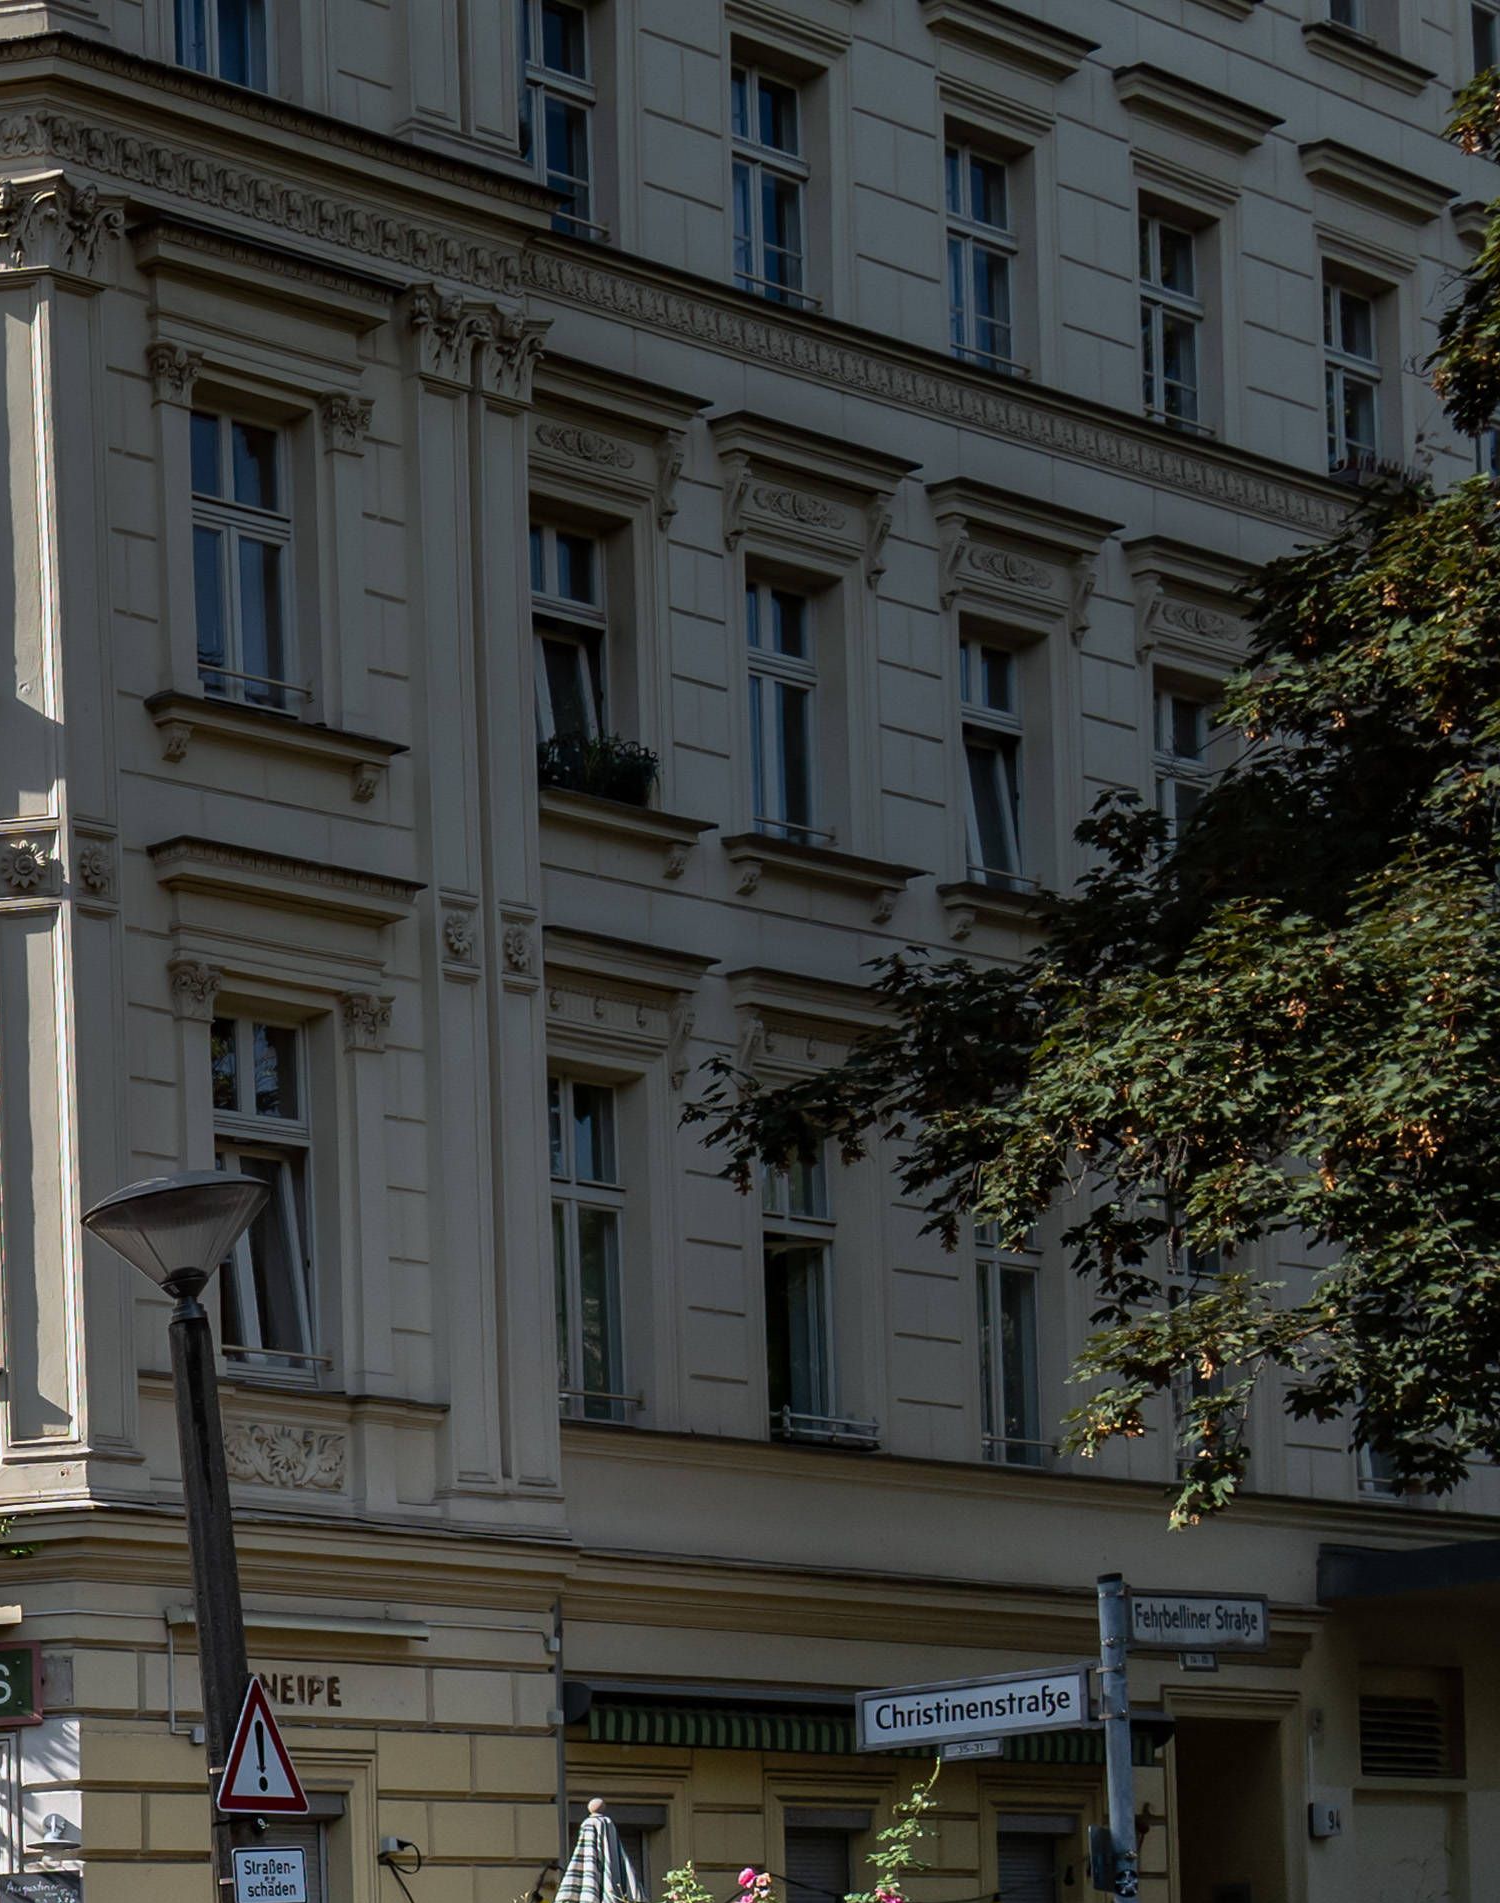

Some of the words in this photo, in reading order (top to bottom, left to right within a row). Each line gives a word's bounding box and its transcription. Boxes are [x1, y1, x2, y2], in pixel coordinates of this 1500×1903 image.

[1135, 1603, 1211, 1630] Fehrbelliner
[1215, 1605, 1257, 1636] Straße
[258, 1672, 342, 1707] NEIPE
[875, 1685, 1071, 1730] Christinenstraße
[244, 1859, 296, 1875] Straßen-
[248, 1881, 296, 1897] schäden
